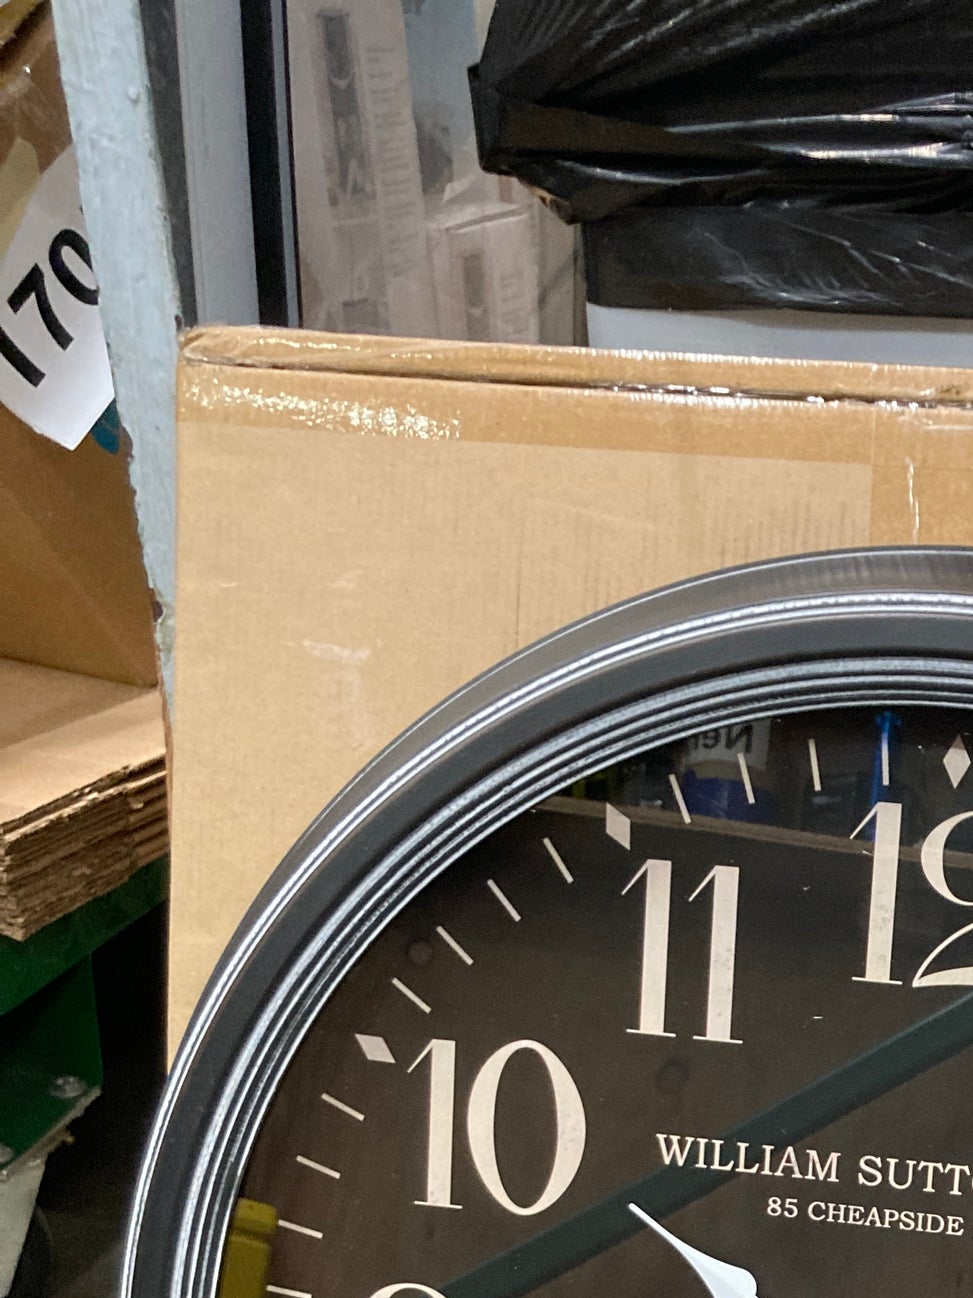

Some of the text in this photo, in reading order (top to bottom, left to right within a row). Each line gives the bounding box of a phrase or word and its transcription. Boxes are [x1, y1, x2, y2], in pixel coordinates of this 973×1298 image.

[621, 858, 743, 1044] 11
[406, 1038, 587, 1216] 10
[655, 1133, 842, 1183] WILLIAM
[766, 1196, 799, 1219] 85
[807, 1201, 965, 1237] CHEAPSIDE
